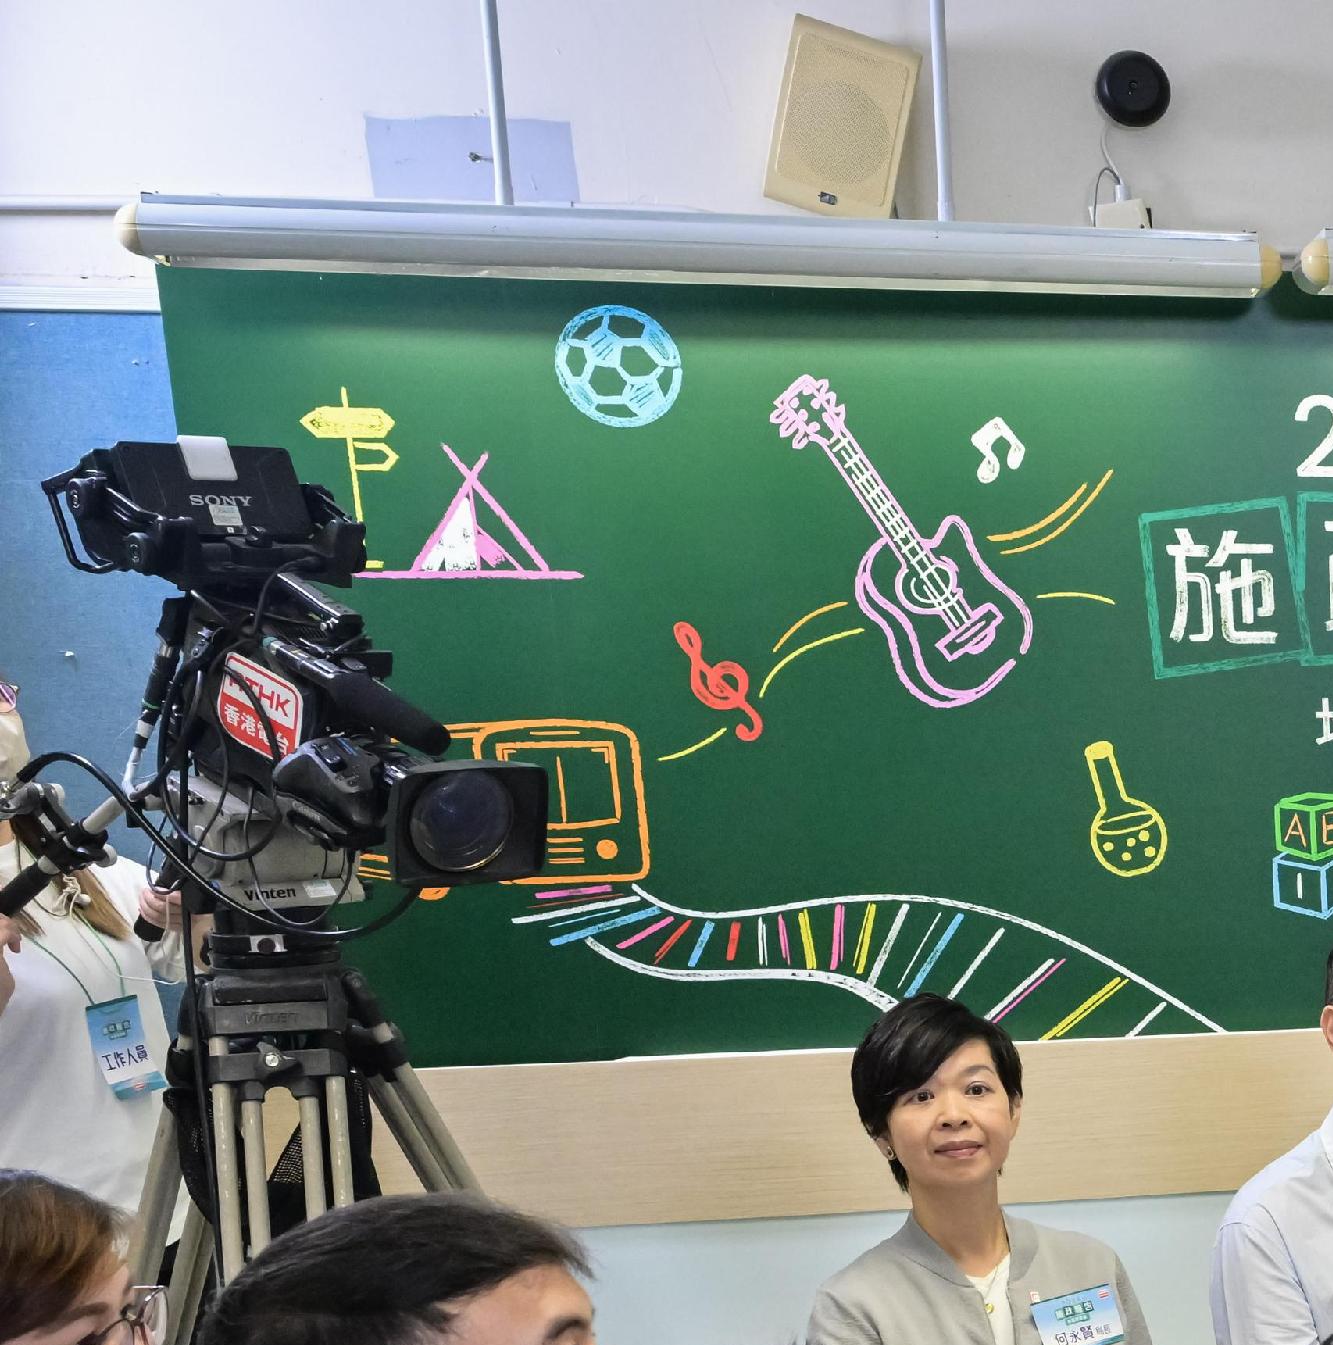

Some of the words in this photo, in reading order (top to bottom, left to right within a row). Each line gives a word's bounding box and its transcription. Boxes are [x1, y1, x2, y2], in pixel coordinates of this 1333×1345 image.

[189, 494, 252, 507] SONY
[1284, 812, 1307, 848] A
[102, 1044, 149, 1071] 工作人員
